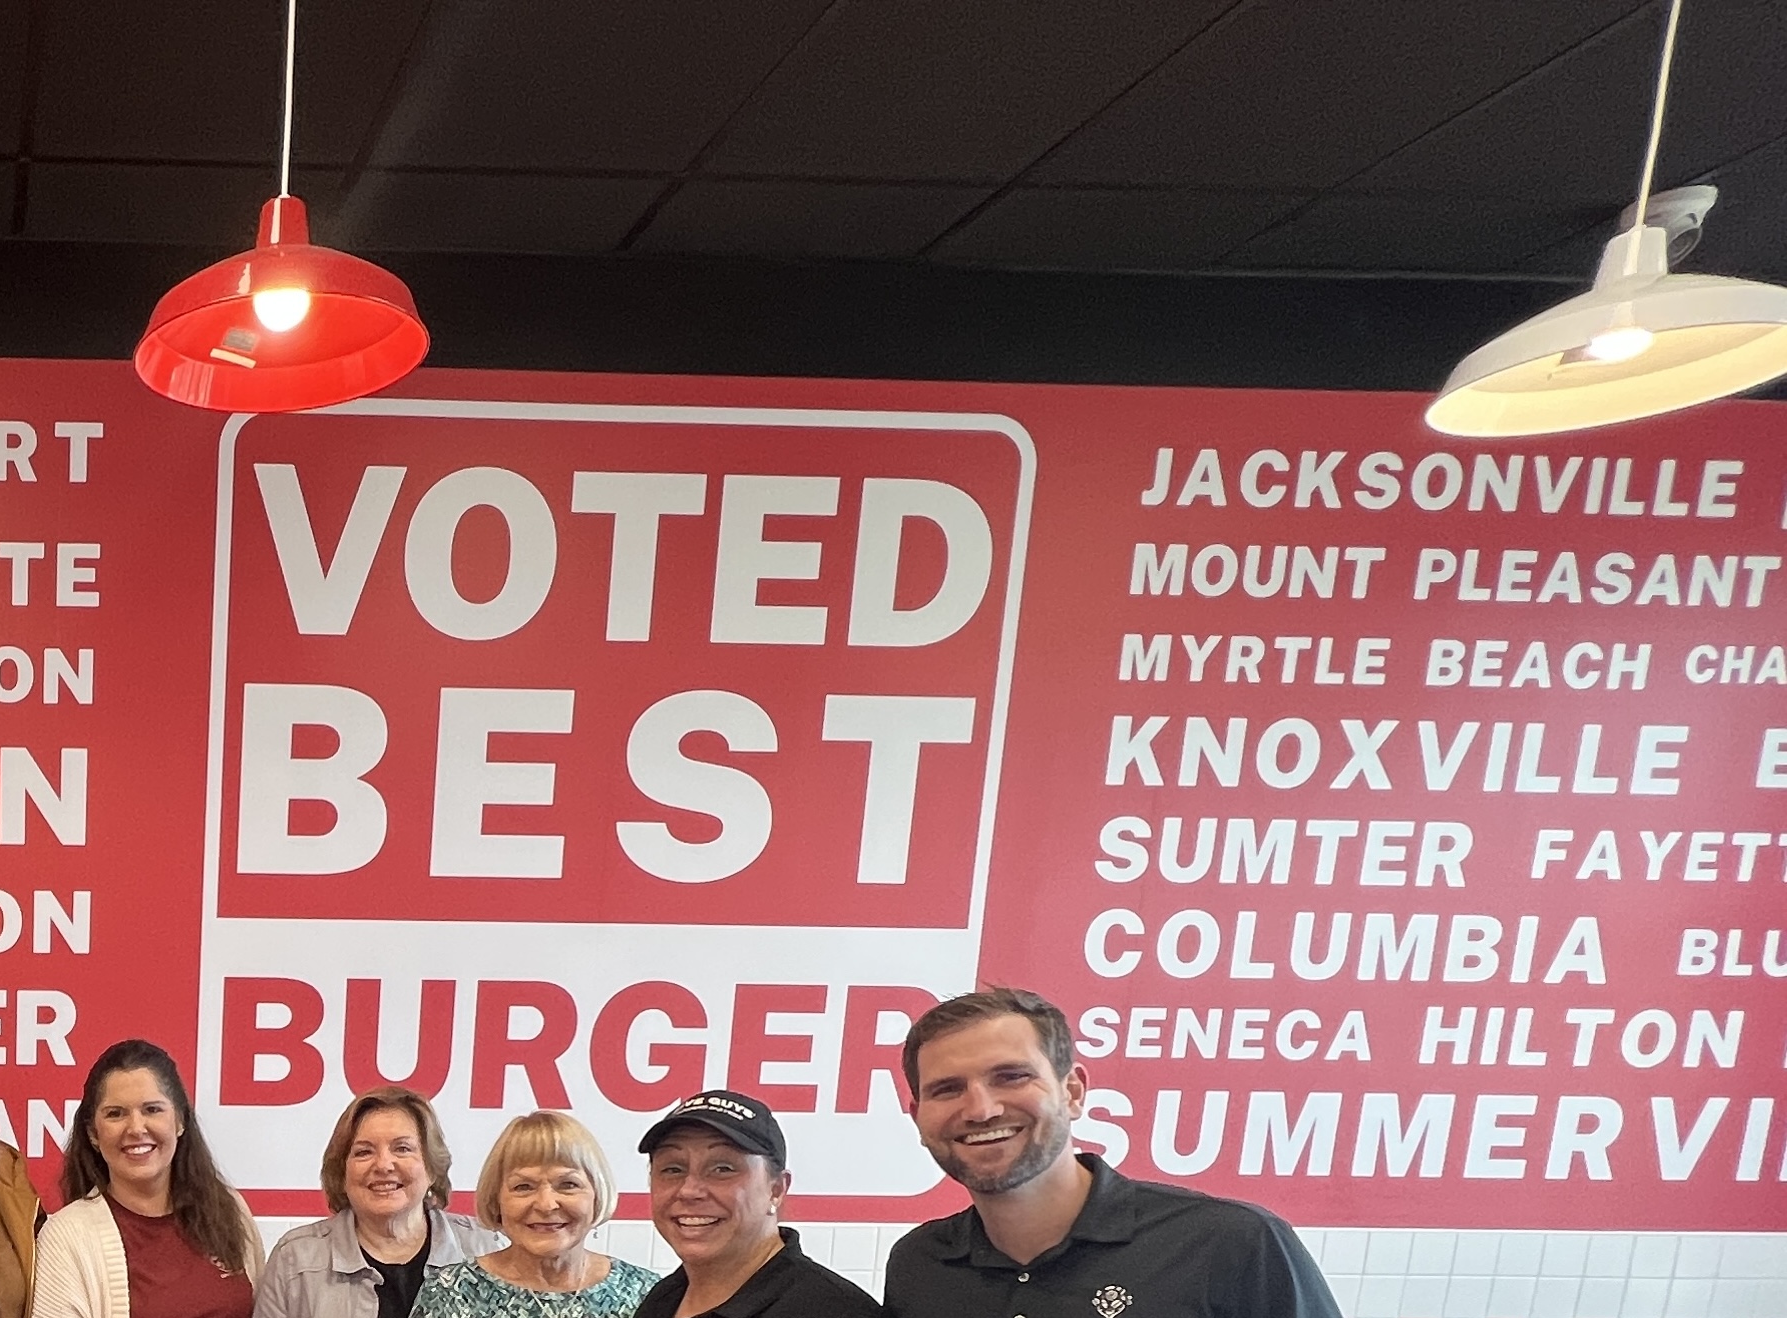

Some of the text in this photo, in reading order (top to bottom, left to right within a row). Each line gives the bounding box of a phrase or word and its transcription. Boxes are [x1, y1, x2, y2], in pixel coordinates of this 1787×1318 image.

[1139, 447, 1744, 519] JACKSONVILLE
[253, 462, 993, 648] VOTED
[1128, 542, 1782, 608] MOUNT PLEASANT
[1117, 632, 1787, 694] MYRTLE BEACH CHA
[235, 682, 977, 886] BEST
[1103, 713, 1693, 798] KNOXVILLE
[1093, 814, 1787, 889] SUMTER FAYET
[1082, 907, 1608, 984] COLUMBIA
[218, 975, 941, 1114] BURGER
[1075, 1006, 1373, 1061] SENECA
[1417, 1004, 1746, 1069] HILTON
[1071, 1088, 1787, 1182] SUMMERVI
